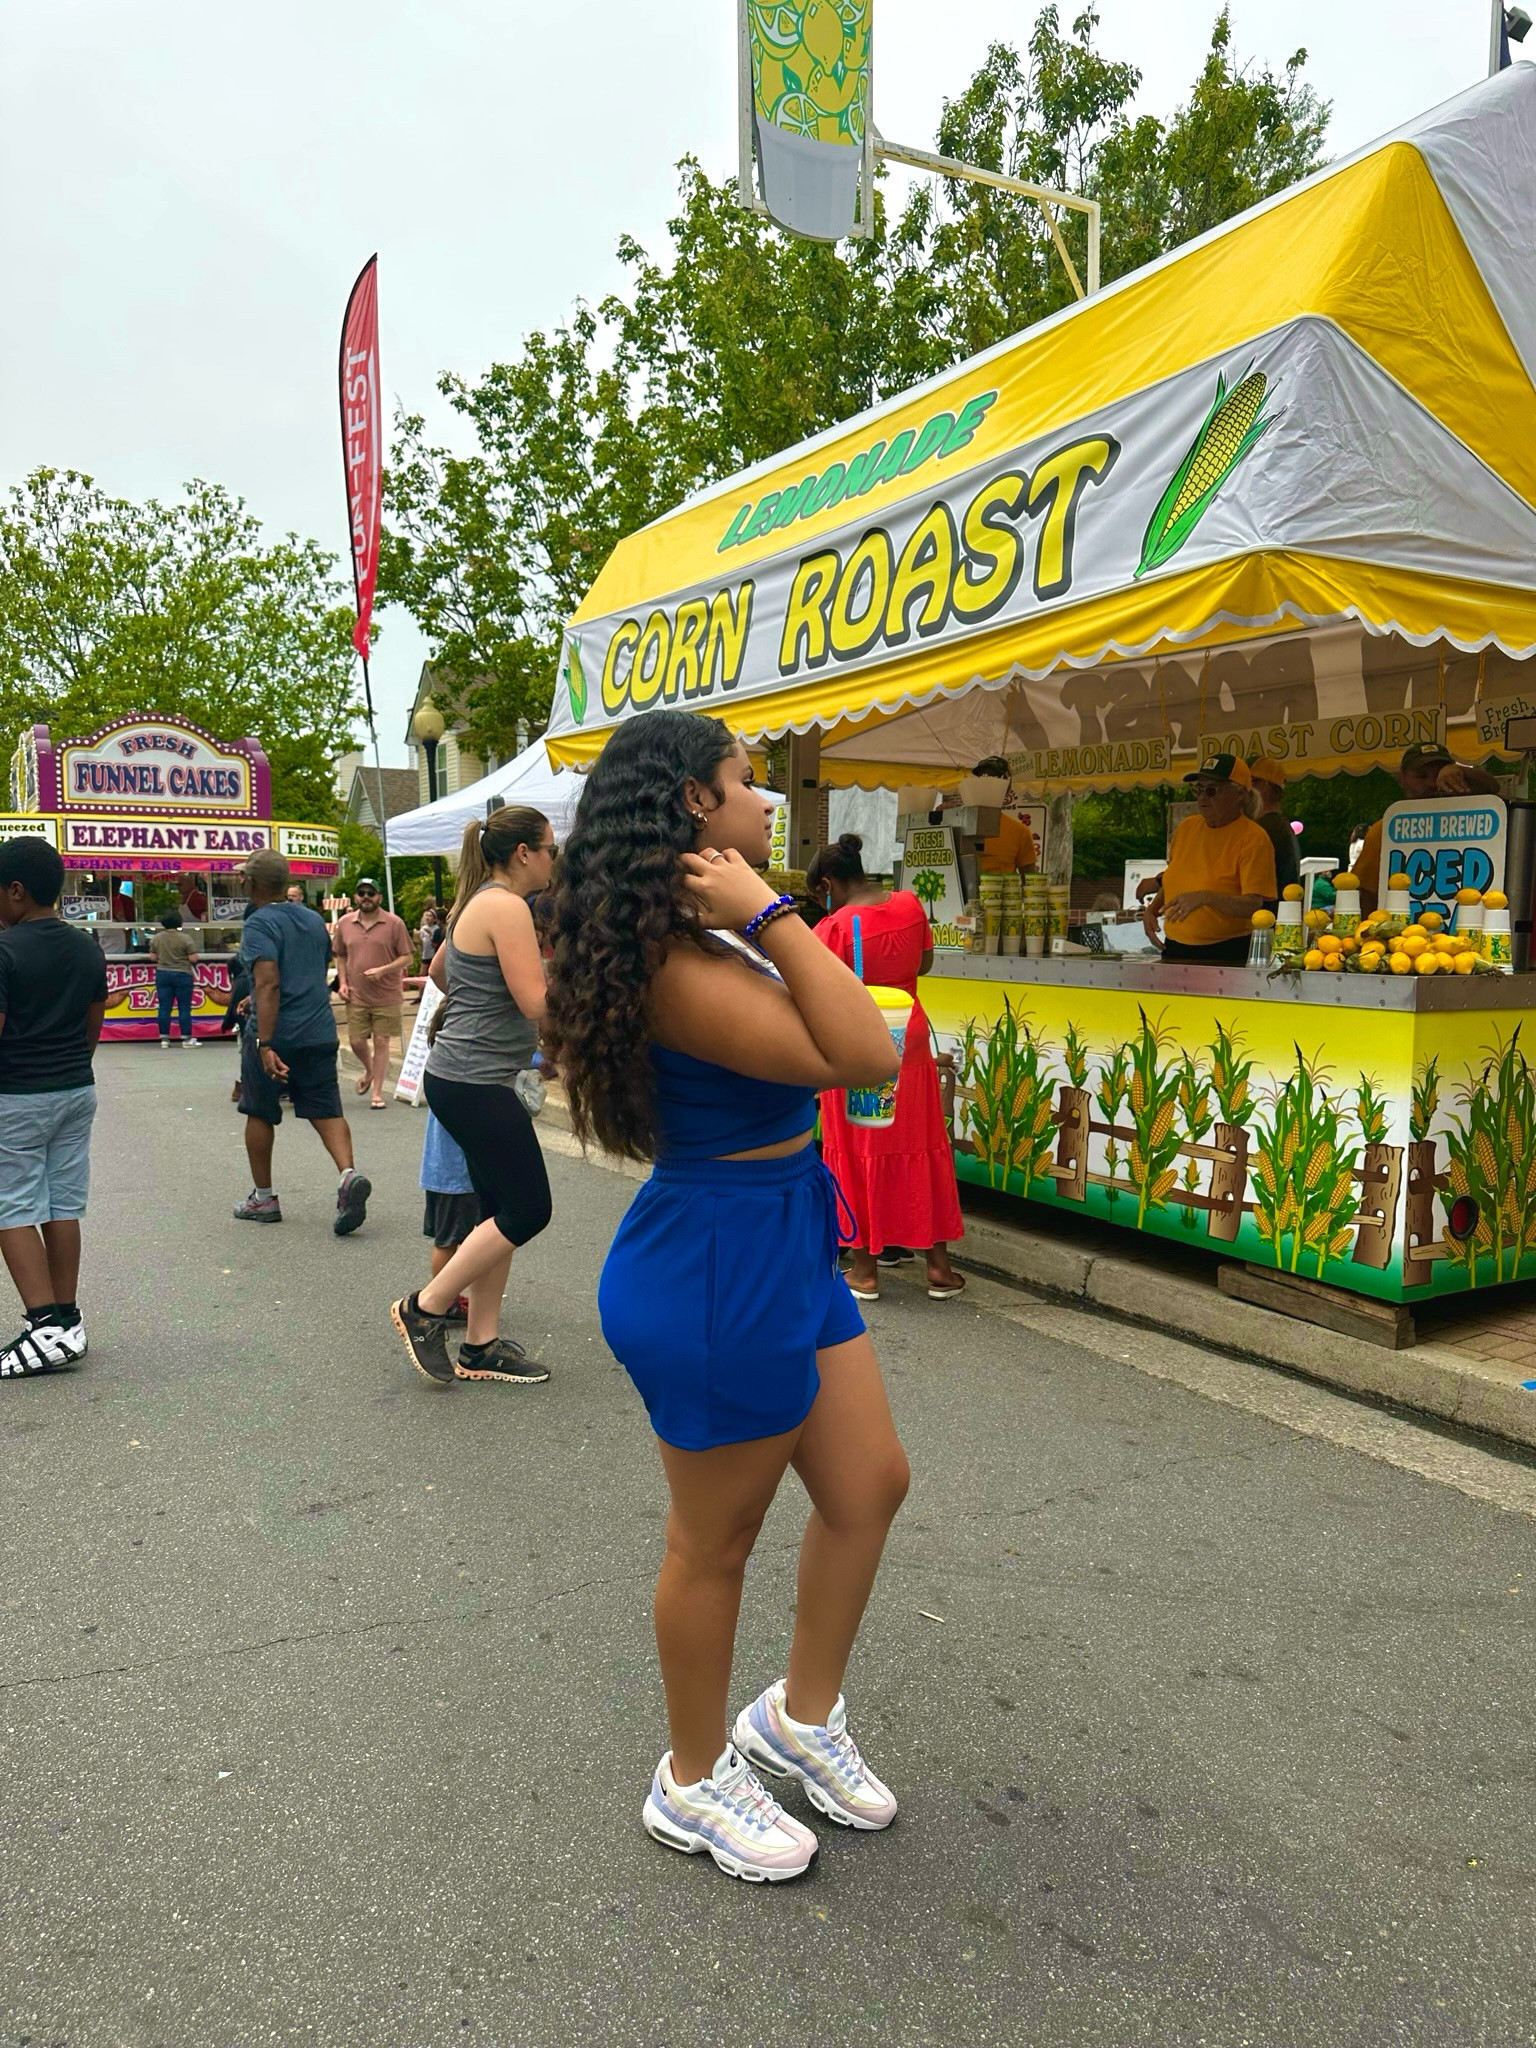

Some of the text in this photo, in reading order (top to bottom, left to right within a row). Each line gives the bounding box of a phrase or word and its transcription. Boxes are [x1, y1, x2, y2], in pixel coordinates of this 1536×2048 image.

[717, 390, 998, 553] LEMONADE
[601, 433, 1121, 717] CORN ROAST
[120, 735, 197, 758] FRESH
[1202, 709, 1440, 763] ROAST CORN
[1034, 739, 1168, 778] LEMONADE
[75, 763, 240, 797] FUNNEL CAKES
[72, 826, 265, 850] ELEPHANT EARS
[287, 831, 318, 841] Fresh
[1394, 814, 1493, 840] FRESH BREWED
[913, 831, 945, 849] FRESH
[141, 860, 181, 870] EARS
[905, 849, 954, 868] SQUEEZED
[1389, 848, 1493, 900] ICED
[848, 1093, 881, 1117] FAIR
